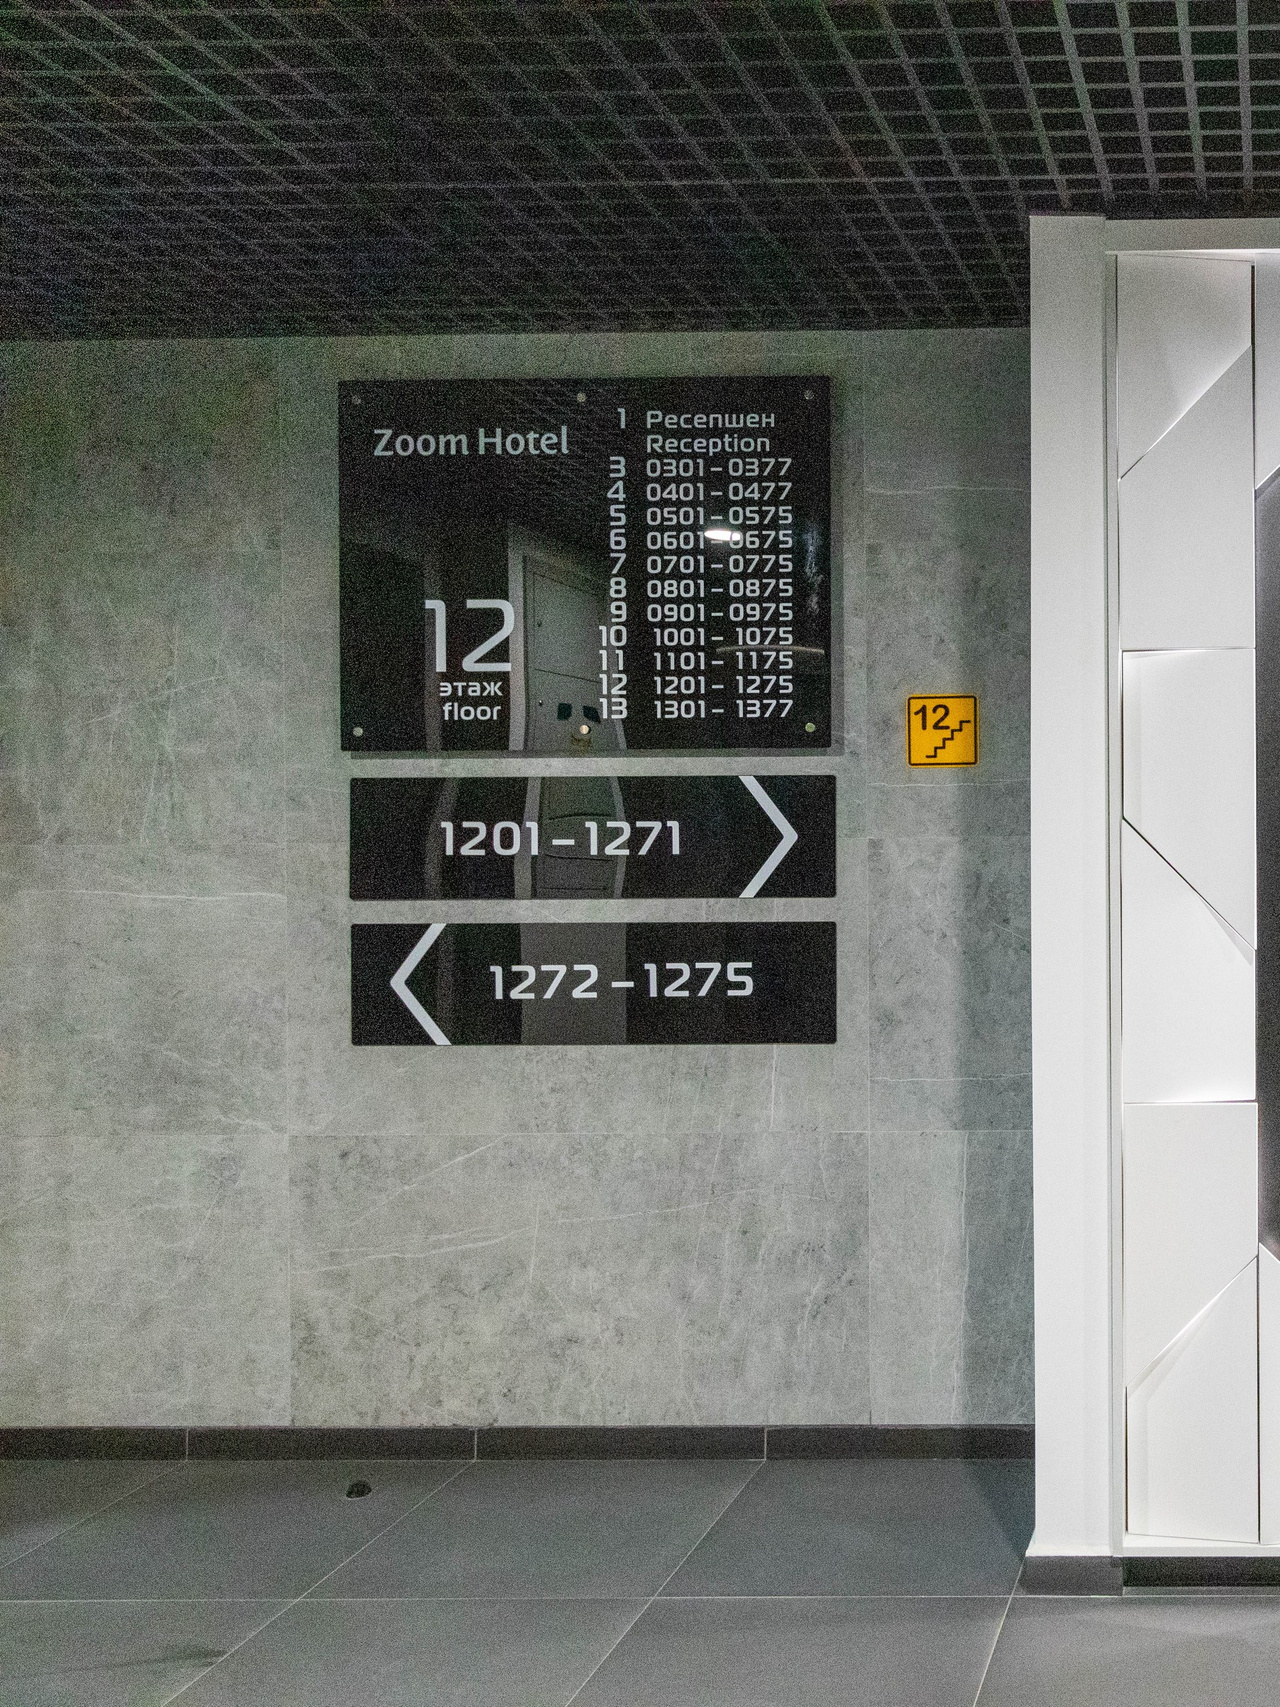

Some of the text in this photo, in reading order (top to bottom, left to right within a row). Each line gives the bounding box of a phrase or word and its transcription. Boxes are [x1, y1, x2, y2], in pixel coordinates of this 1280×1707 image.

[617, 408, 775, 429] 1 Ресепшен
[374, 425, 570, 456] Zoom Hotel
[646, 434, 770, 456] Reception
[609, 456, 626, 478] 3
[646, 458, 704, 477] 0301
[729, 458, 792, 477] 0377
[606, 480, 626, 501] 4
[646, 483, 704, 501] 0401
[729, 482, 793, 500] 0477
[609, 504, 626, 526] 5
[646, 507, 704, 525] 0501
[729, 506, 793, 525] 0575
[609, 529, 627, 550] 6
[646, 531, 705, 550] 0601
[610, 553, 627, 574] 7
[647, 555, 705, 574] 0701
[729, 555, 793, 573] 0775
[609, 577, 627, 598] 8
[647, 579, 705, 598] 0801
[729, 579, 793, 597] 0875
[610, 601, 627, 622] 9
[647, 604, 705, 622] 0901
[729, 603, 793, 621] 0975
[424, 600, 515, 672] 12
[599, 625, 627, 646] 10
[654, 628, 705, 646] 1001
[736, 627, 793, 645] 1075
[599, 649, 624, 671] 11
[654, 652, 705, 670] 1101
[736, 651, 793, 670] 1175
[439, 681, 503, 697] этаж
[599, 673, 628, 695] 12
[654, 676, 706, 695] 1201
[736, 675, 794, 694] 1275
[442, 702, 502, 721] floor
[600, 698, 628, 719] 13
[654, 700, 706, 719] 1301
[736, 700, 794, 718] 1377
[913, 704, 951, 731] 12
[440, 821, 539, 856] 1201
[584, 821, 681, 856] 1271
[490, 964, 599, 1000] 1272
[644, 961, 754, 998] 1275
